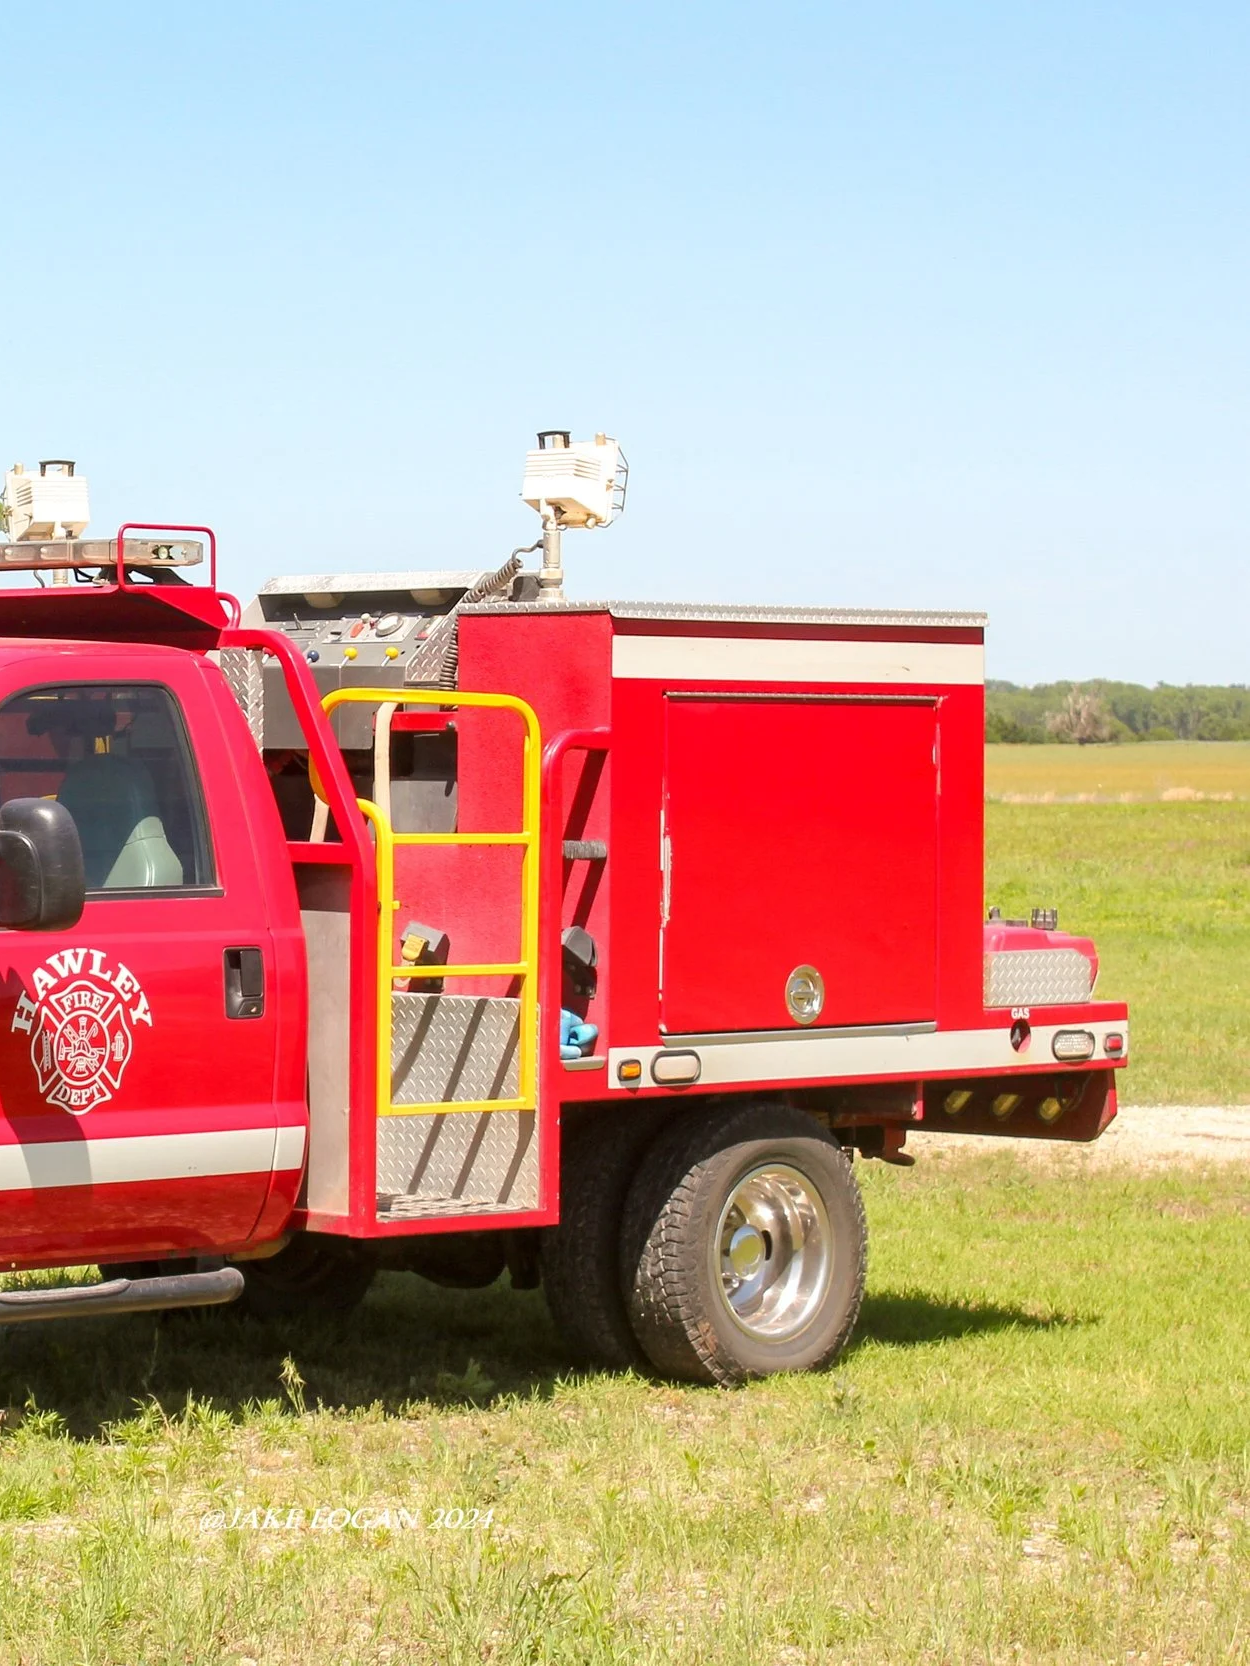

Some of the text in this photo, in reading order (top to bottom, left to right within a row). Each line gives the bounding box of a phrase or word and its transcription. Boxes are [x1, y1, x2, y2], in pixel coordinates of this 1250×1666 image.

[11, 947, 153, 1036] HAWLEY
[60, 990, 103, 1014] FIRE
[1011, 1007, 1030, 1020] GAS
[56, 1083, 102, 1106] DEPT
